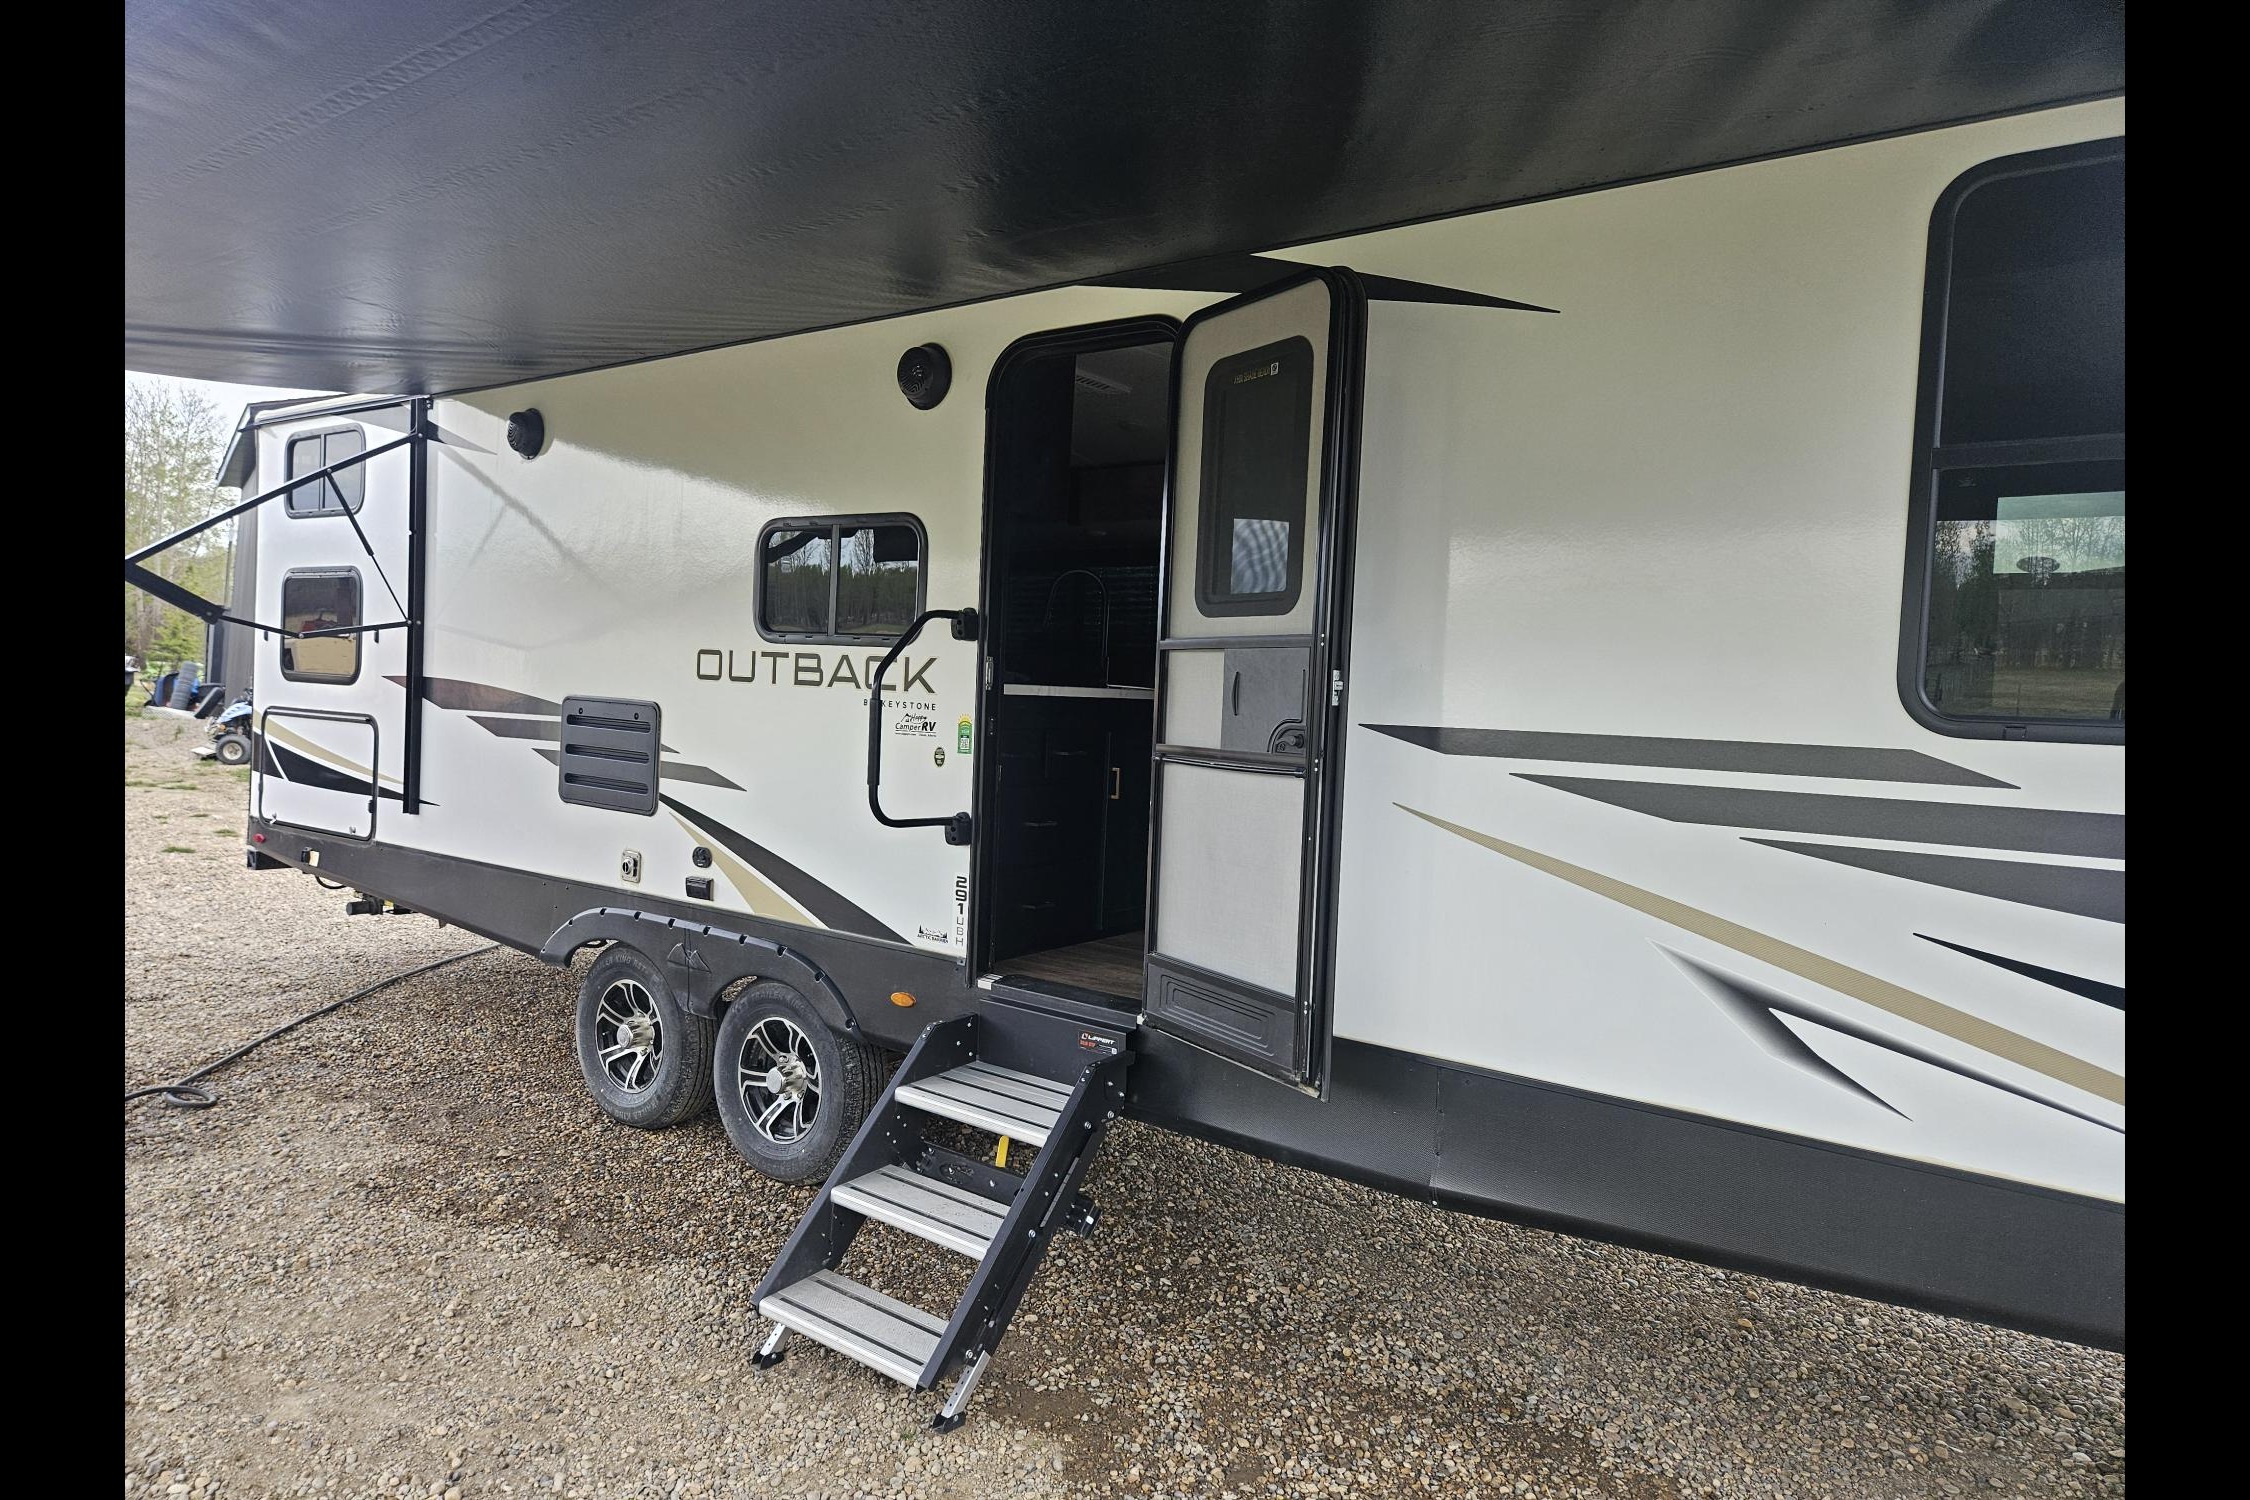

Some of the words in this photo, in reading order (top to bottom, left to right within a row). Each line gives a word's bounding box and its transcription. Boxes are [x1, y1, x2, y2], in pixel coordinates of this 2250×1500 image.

[696, 648, 938, 694] OUTBACK
[881, 700, 936, 711] KEYSTONE
[895, 722, 922, 732] Camper
[922, 721, 937, 732] RV
